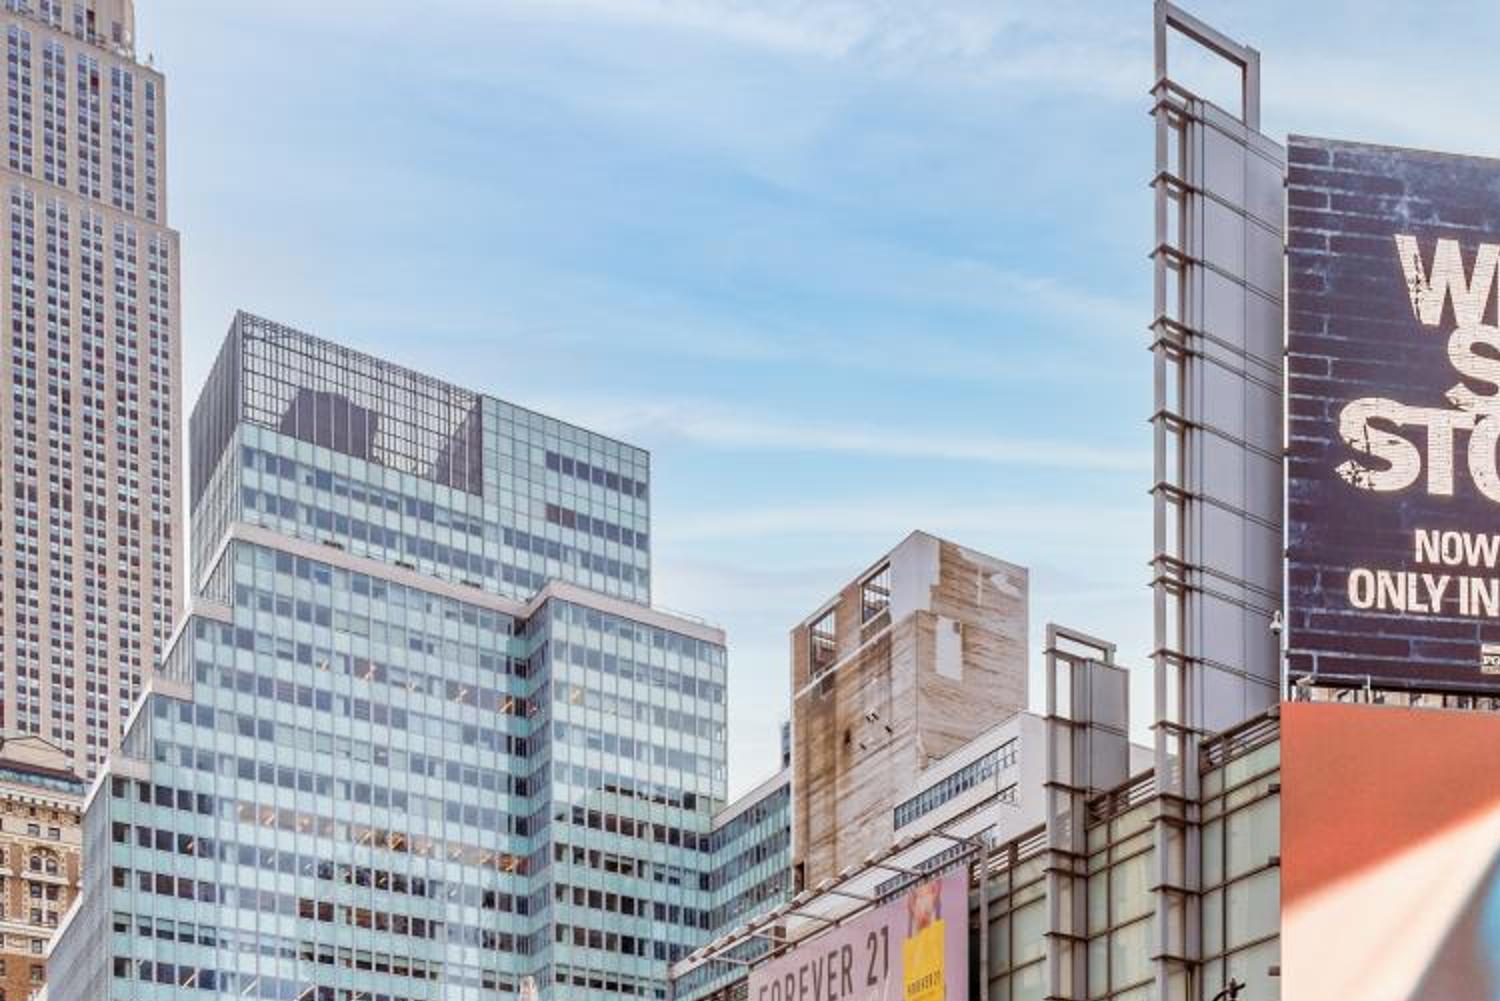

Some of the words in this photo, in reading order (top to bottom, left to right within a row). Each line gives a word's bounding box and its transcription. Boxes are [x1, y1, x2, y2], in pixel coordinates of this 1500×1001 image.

[1414, 528, 1500, 569] NOW
[1348, 568, 1450, 613] ONLY
[1458, 577, 1499, 617] IN
[866, 925, 890, 988] 21
